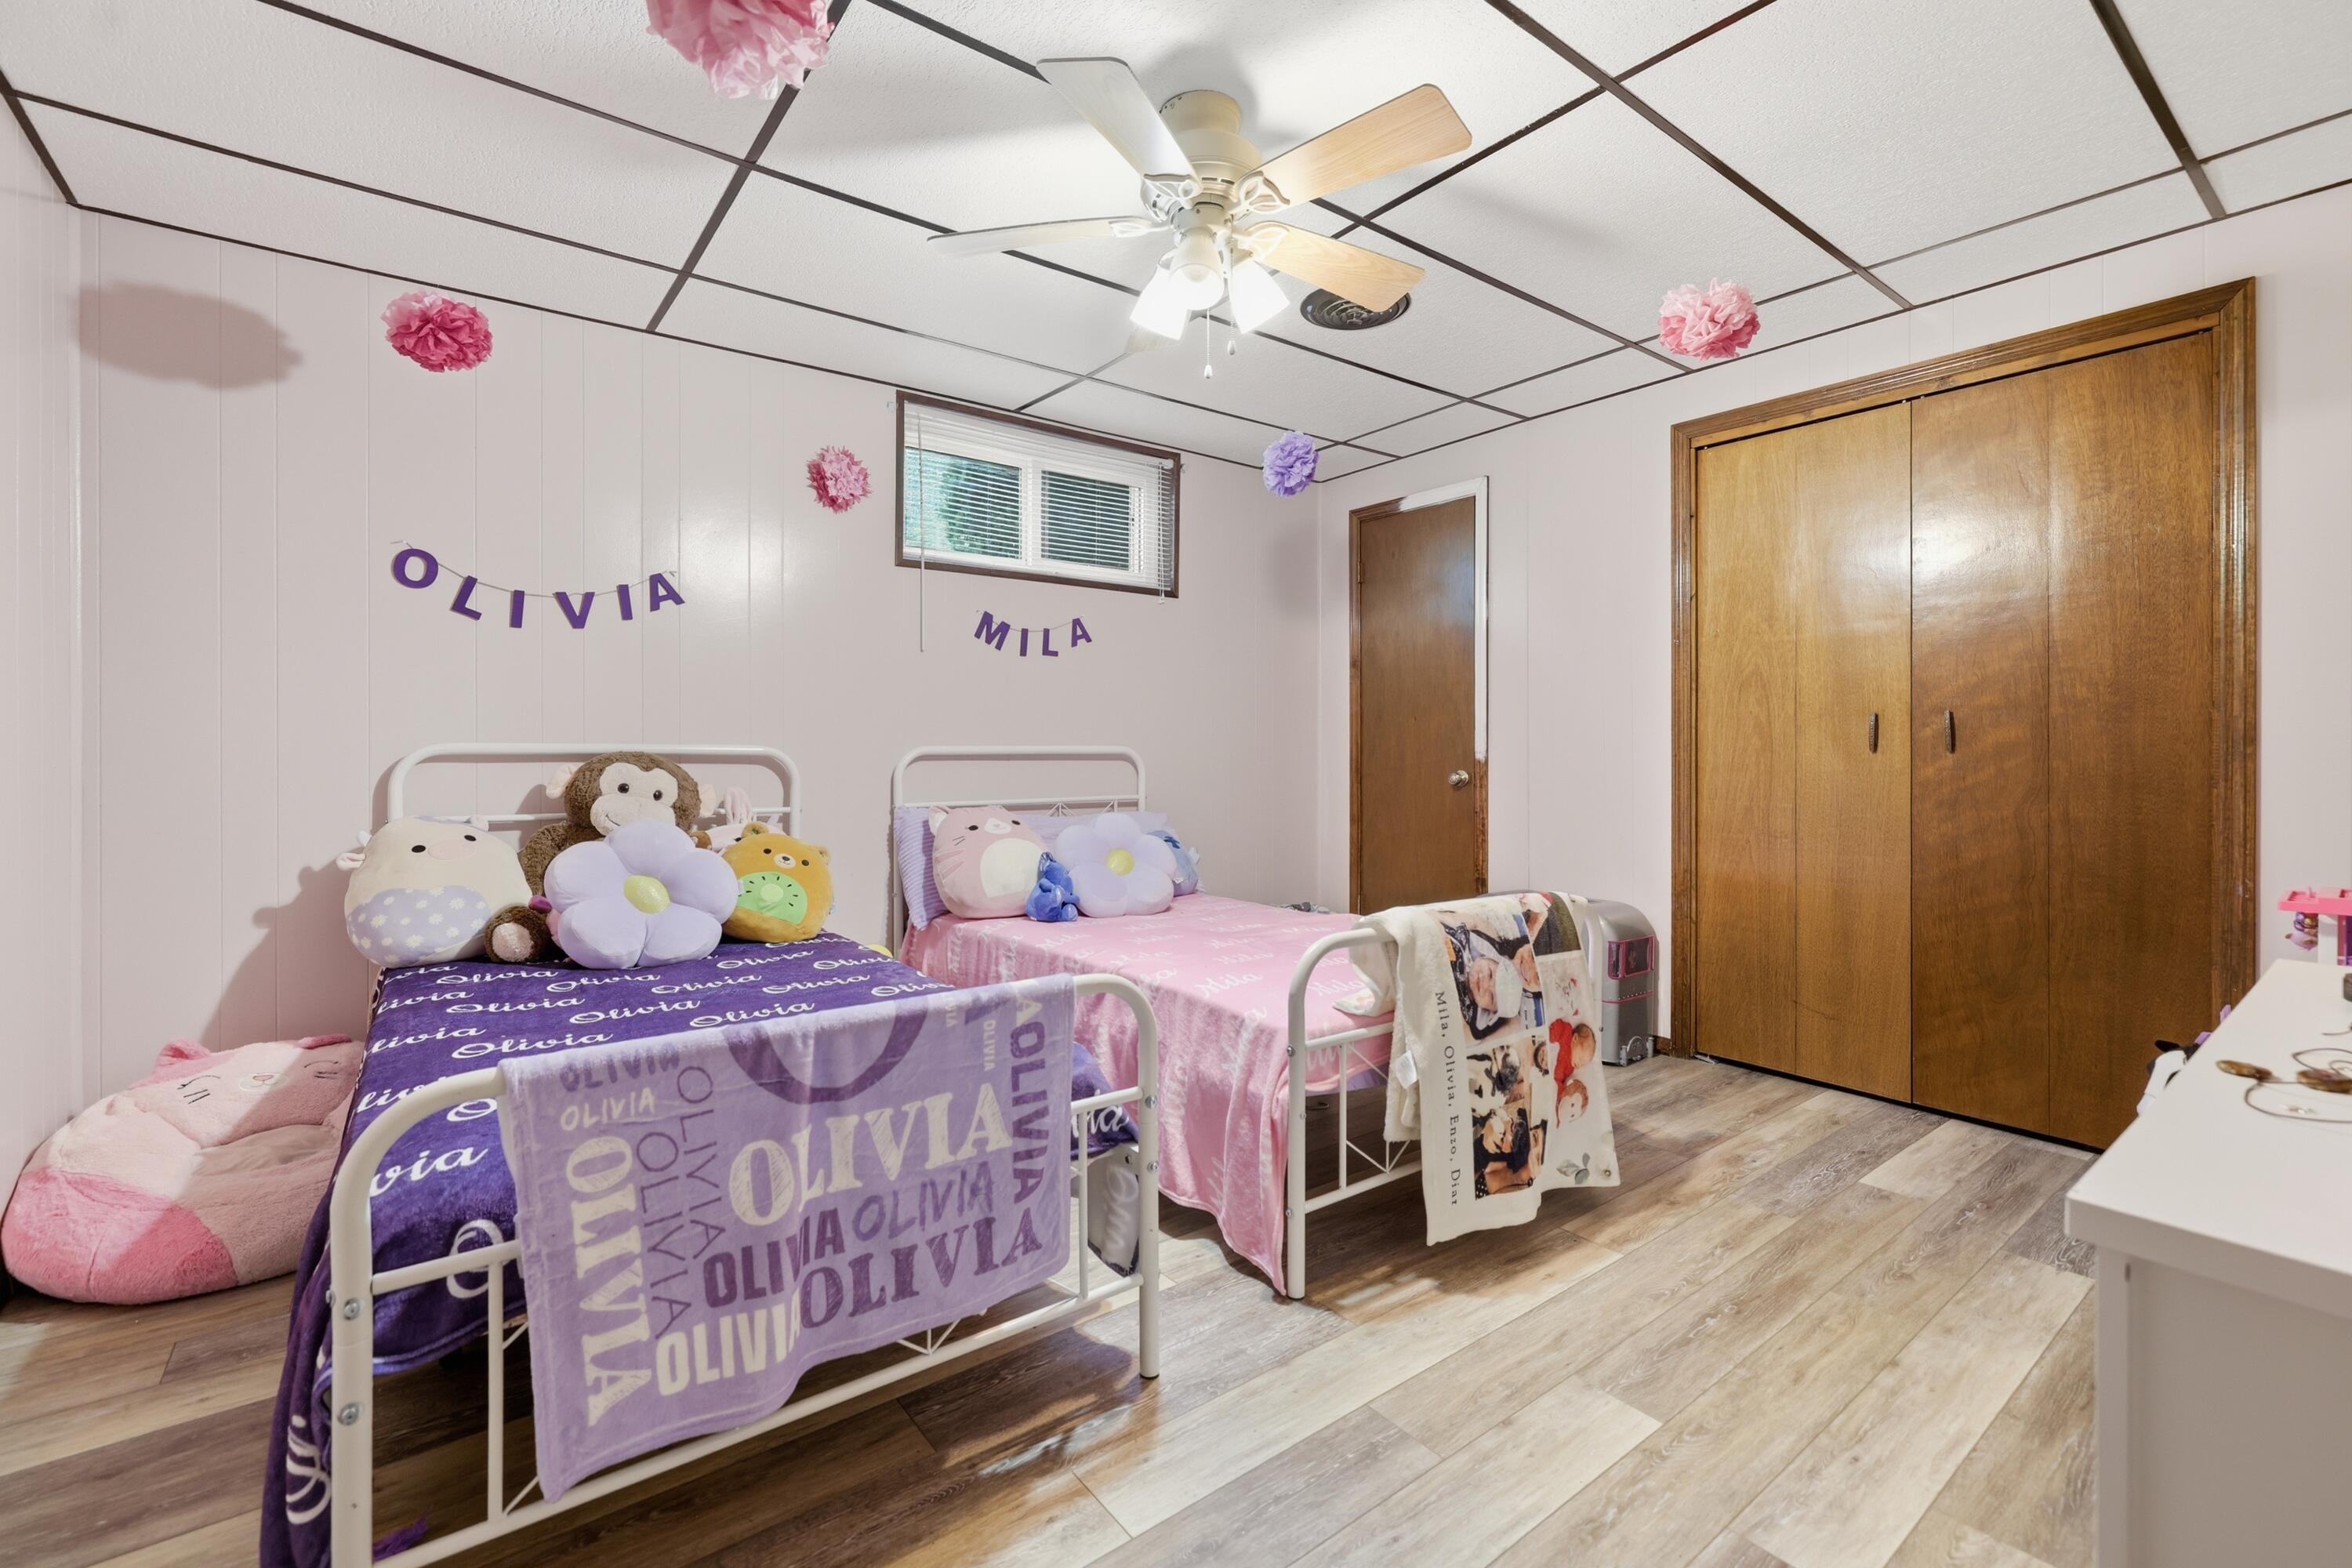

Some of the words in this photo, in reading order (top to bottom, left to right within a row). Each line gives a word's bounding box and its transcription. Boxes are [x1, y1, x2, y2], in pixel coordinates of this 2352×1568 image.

[392, 548, 685, 629] OLIVIA
[974, 611, 1092, 657] MILA
[436, 970, 558, 985] Olivia
[717, 949, 814, 969] Olivia
[376, 991, 474, 1015] livia
[446, 997, 586, 1013] Olivia
[546, 975, 661, 993] Olivia
[652, 975, 762, 994] Olivia
[762, 974, 870, 994] Olivia
[1194, 973, 1264, 1000] Mila
[569, 1000, 700, 1025] Olivia
[690, 1001, 815, 1028] Olivia
[1435, 990, 1450, 1037] Mila,
[370, 1027, 487, 1054] livia
[452, 1033, 614, 1059] Olivia
[984, 1020, 996, 1072] OLIVIA
[1443, 1045, 1457, 1107] Olivia,
[561, 1087, 655, 1131] OLIVIA
[1011, 1022, 1050, 1204] OLIVIA
[729, 1083, 1012, 1226] OLIVIA
[1449, 1114, 1459, 1162] Enzo,
[677, 1066, 726, 1260] OLIVIA
[852, 1161, 994, 1241] OLIVIA
[637, 1132, 691, 1339] OLIVIA
[703, 1207, 846, 1308] OLIVIA
[566, 1136, 652, 1427] OLIVIA
[800, 1207, 1044, 1329] OLIVIA
